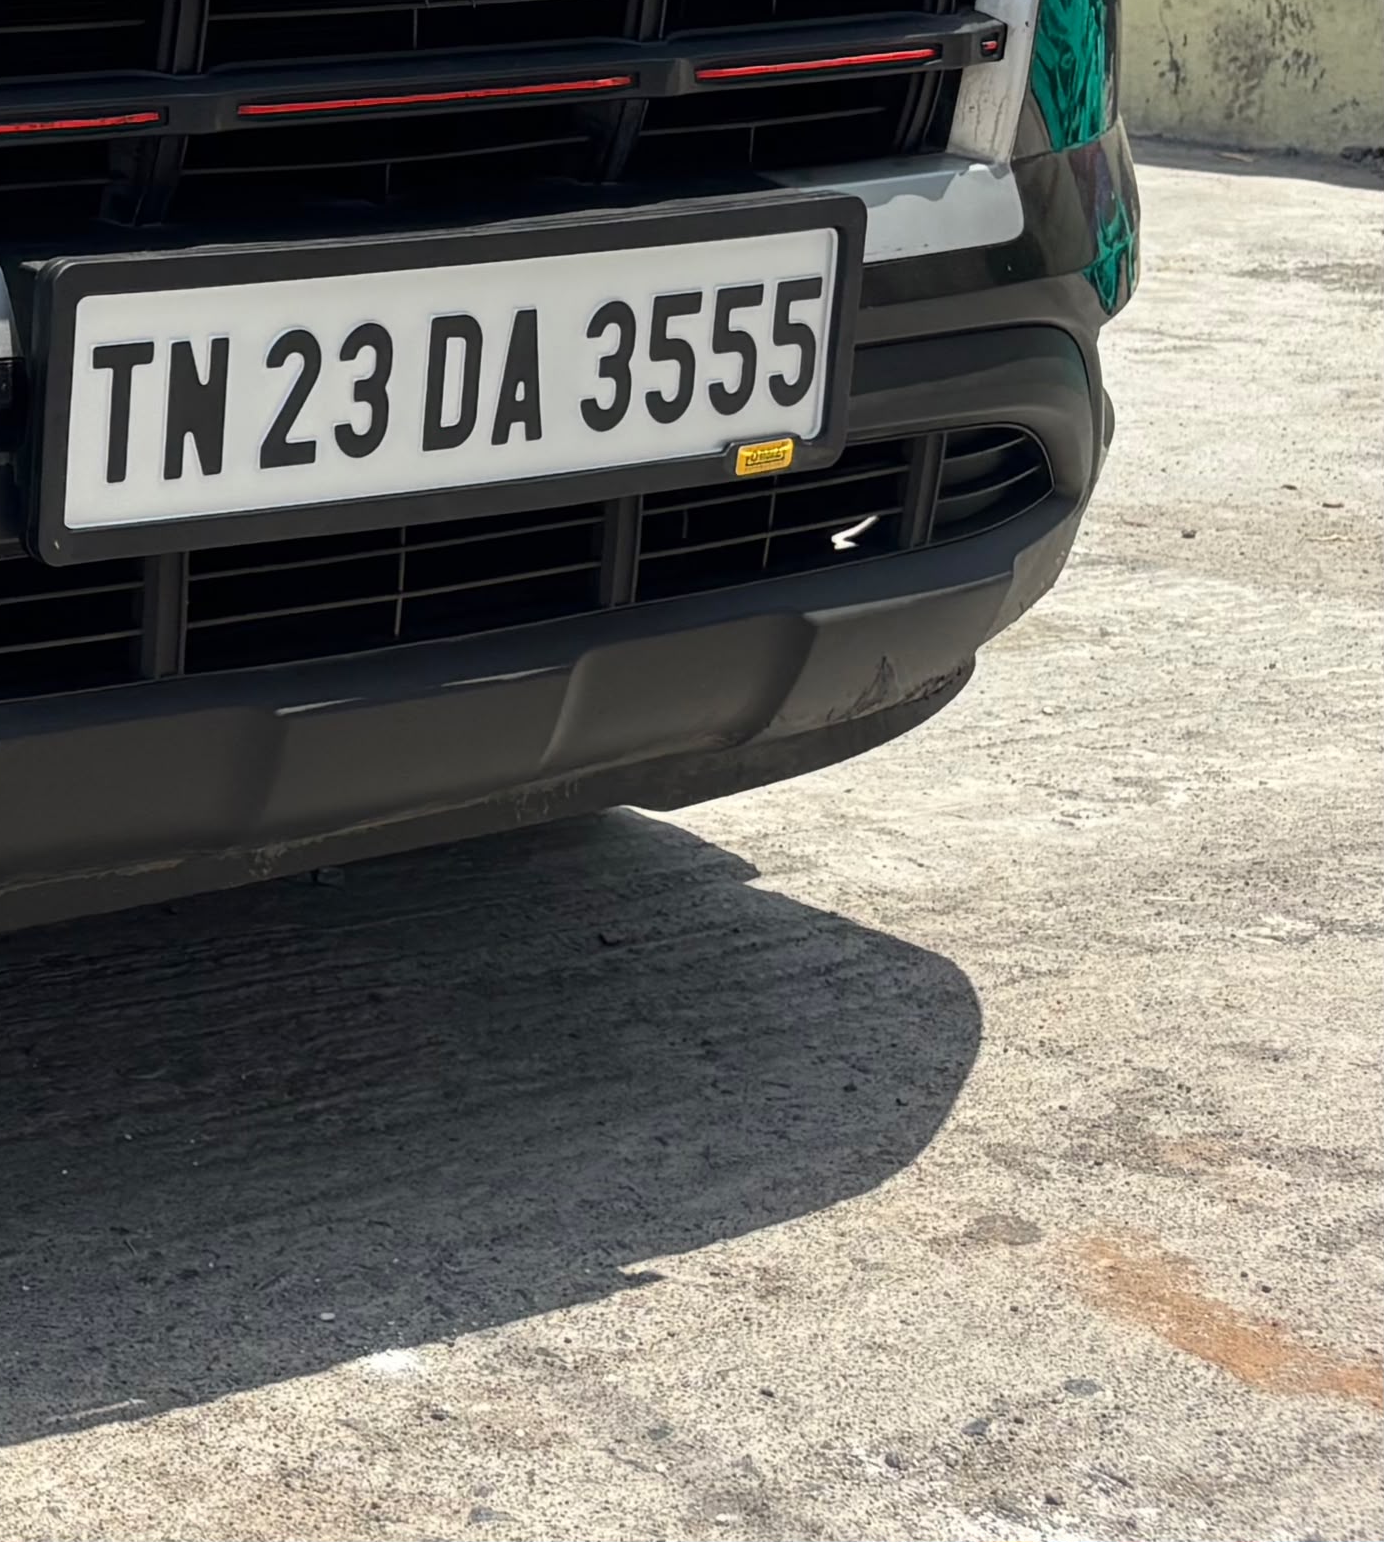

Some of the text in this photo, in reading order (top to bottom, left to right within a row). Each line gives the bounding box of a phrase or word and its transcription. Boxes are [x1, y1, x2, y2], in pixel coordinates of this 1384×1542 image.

[92, 276, 824, 484] TN 23 DA 3555
